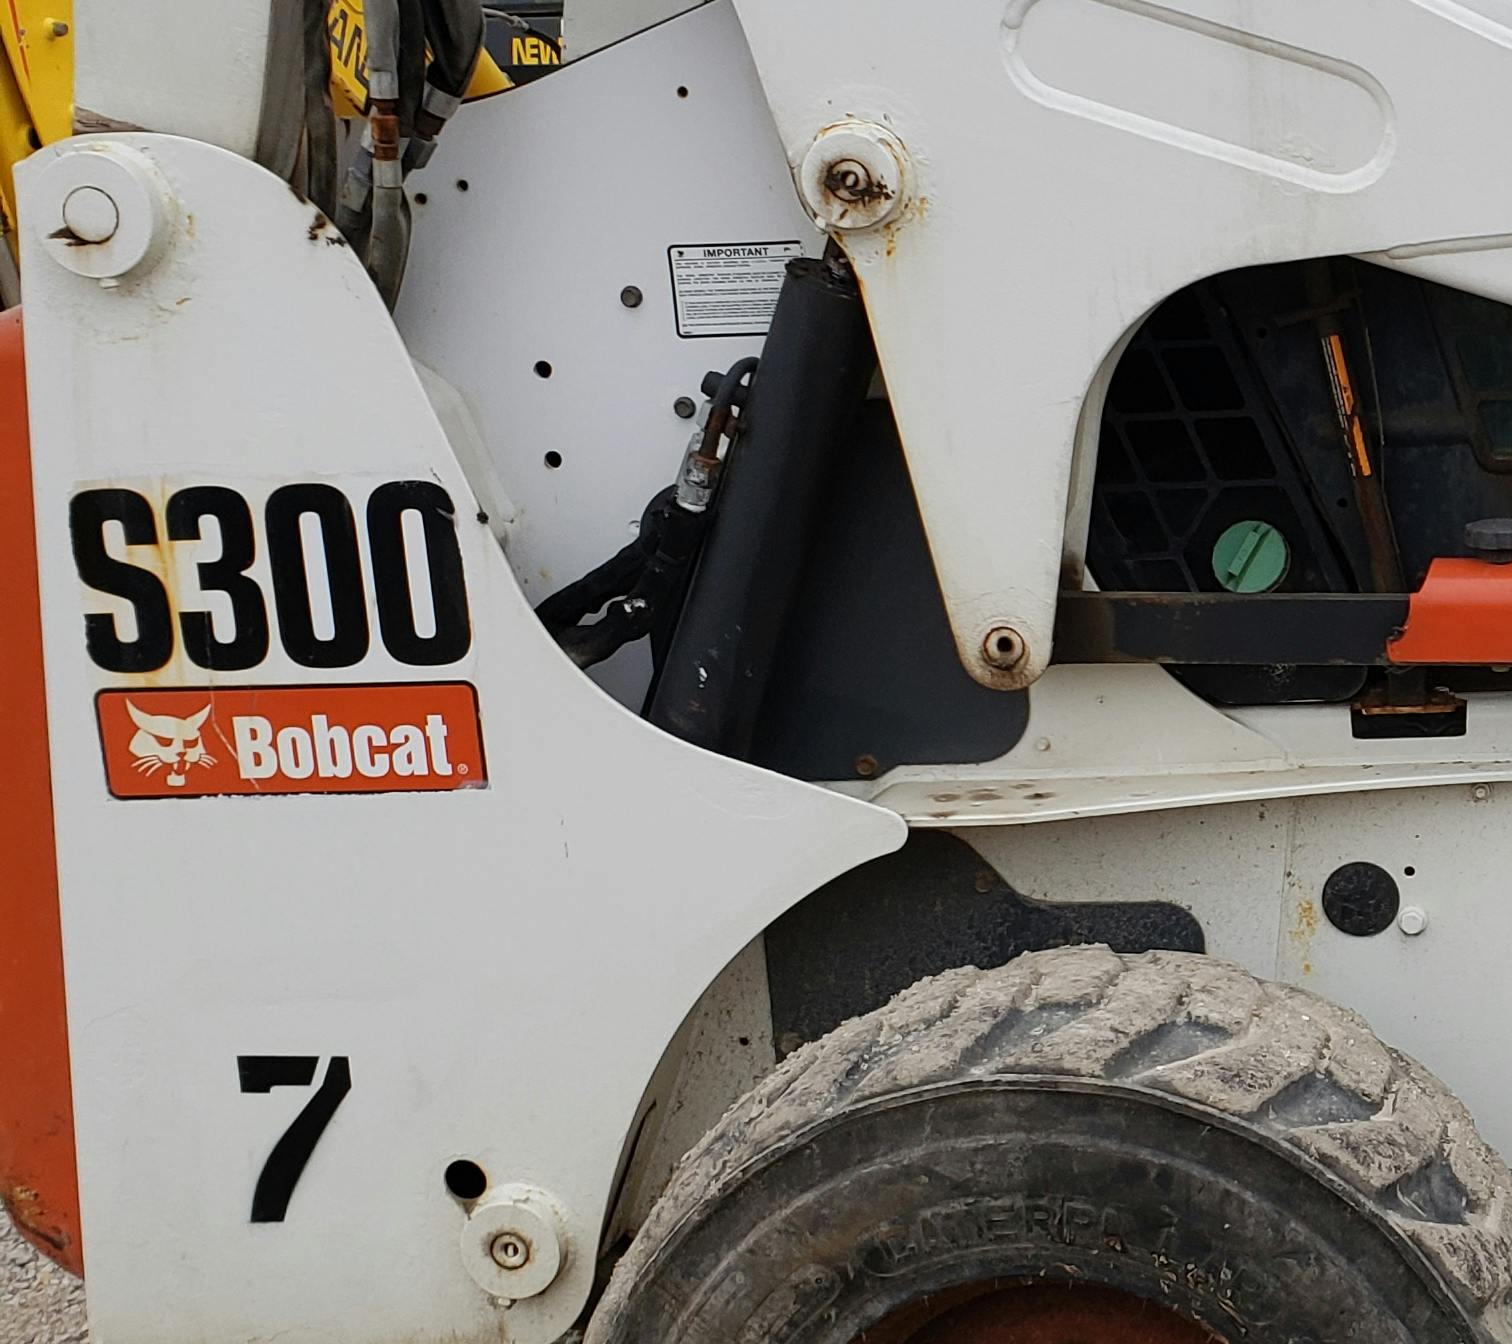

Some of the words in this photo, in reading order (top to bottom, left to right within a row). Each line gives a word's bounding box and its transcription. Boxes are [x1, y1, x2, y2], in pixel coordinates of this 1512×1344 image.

[703, 247, 769, 258] IMPORTANT
[69, 480, 472, 674] S300
[232, 713, 453, 780] Bobcat
[237, 1056, 352, 1223] 7
